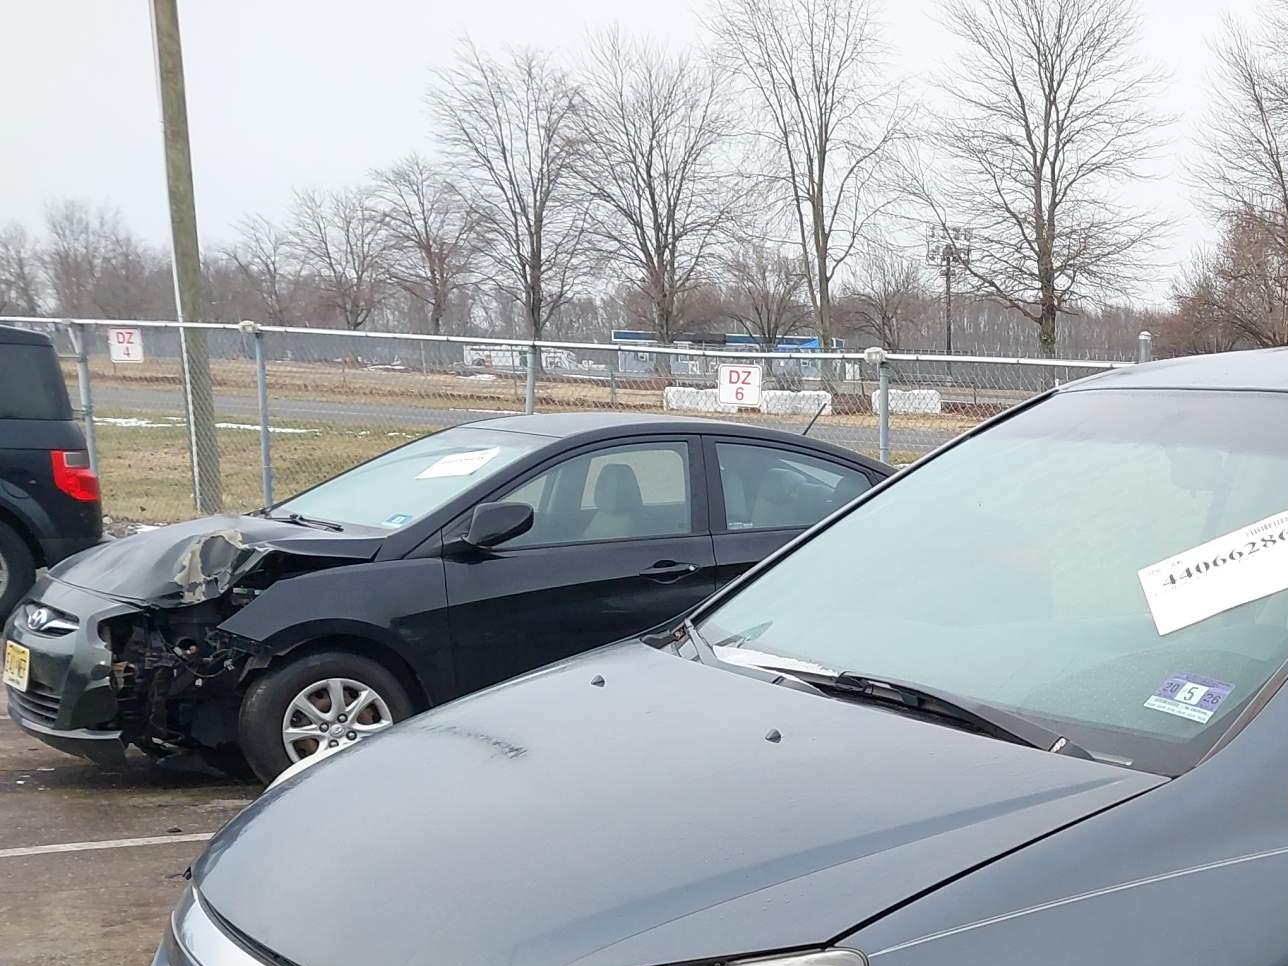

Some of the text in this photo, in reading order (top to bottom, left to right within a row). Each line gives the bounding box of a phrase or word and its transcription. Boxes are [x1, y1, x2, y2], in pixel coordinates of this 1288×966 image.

[116, 331, 134, 344] DZ
[123, 346, 130, 358] 4
[729, 370, 752, 385] DZ
[735, 386, 744, 401] 6
[1183, 686, 1199, 701] 5
